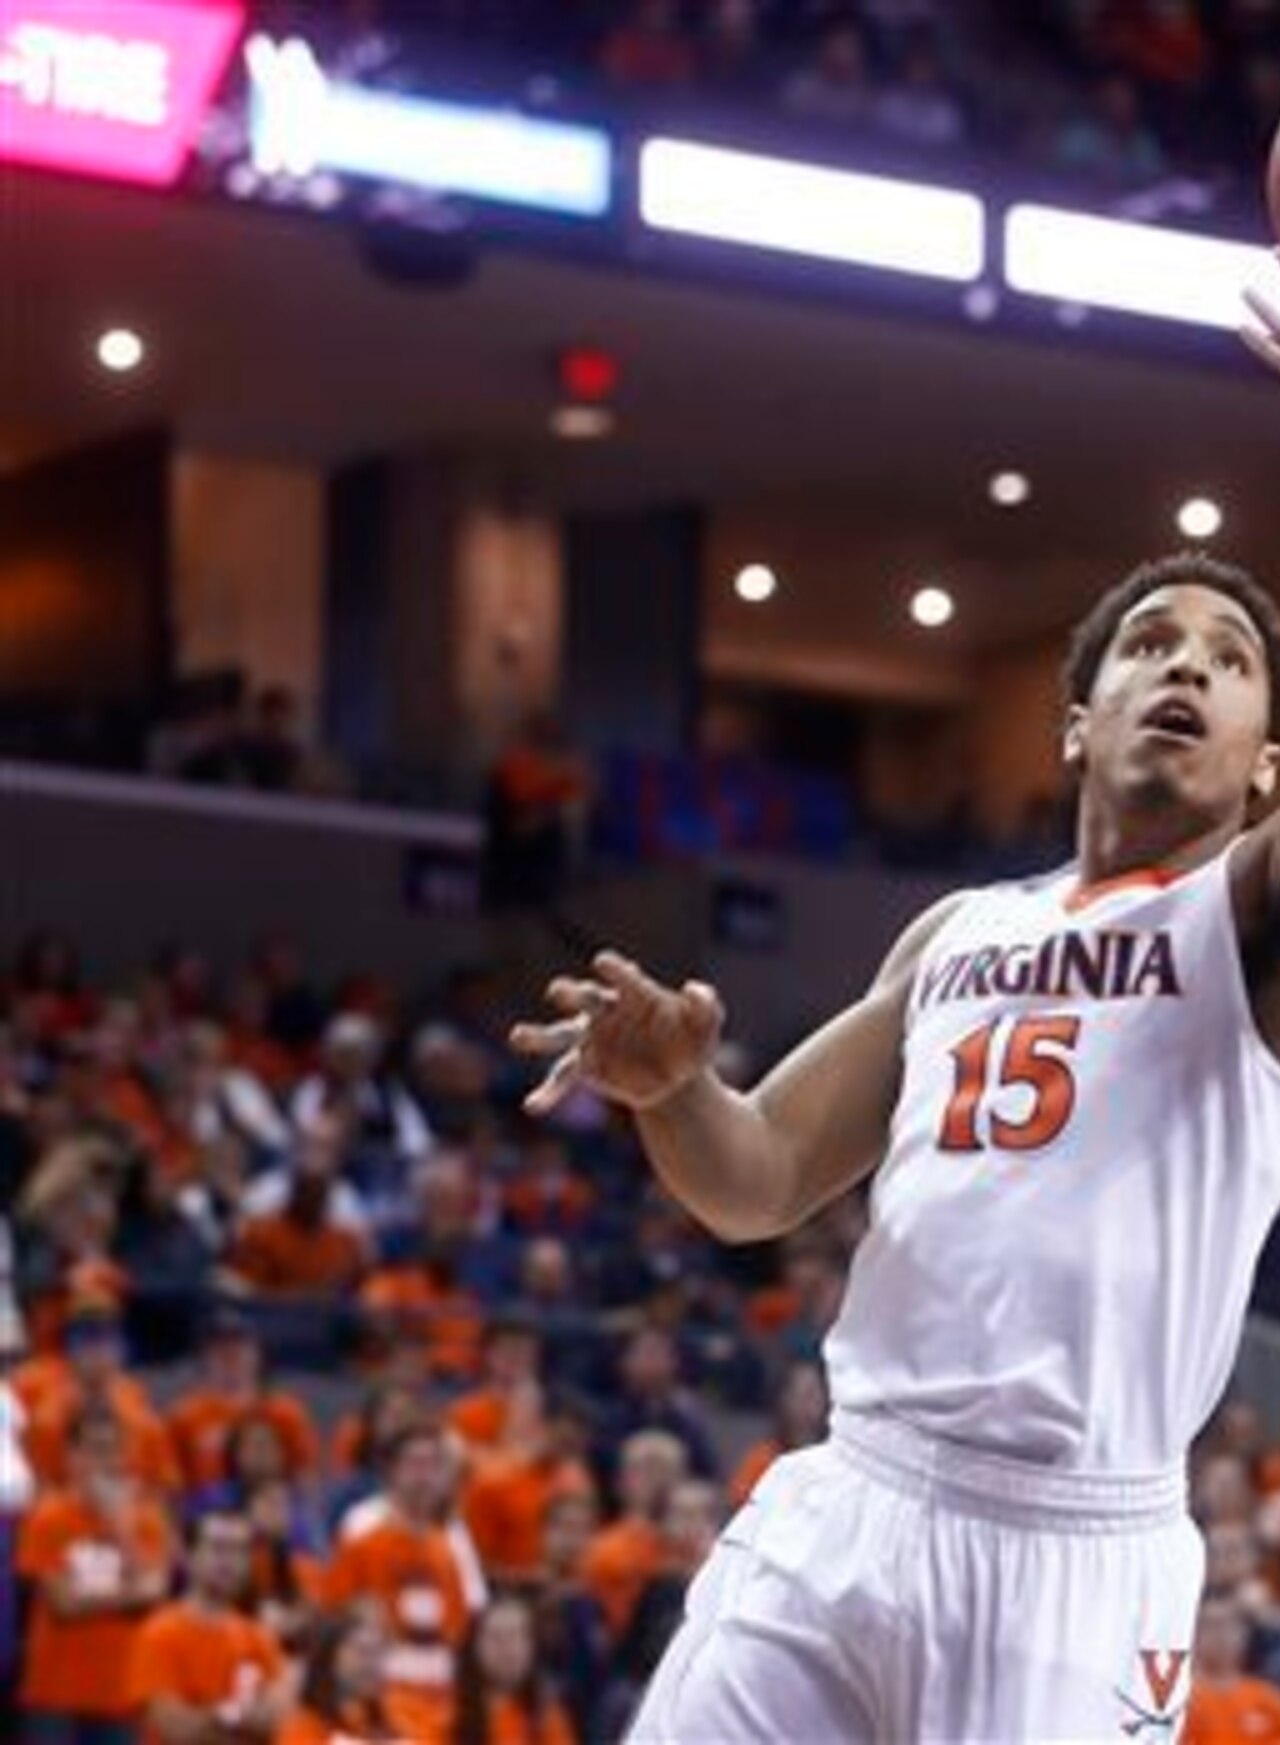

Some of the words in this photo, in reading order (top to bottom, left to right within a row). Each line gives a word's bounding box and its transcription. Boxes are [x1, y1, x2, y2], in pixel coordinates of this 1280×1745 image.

[919, 929, 1183, 1009] VIRGINIA
[937, 1014, 1082, 1153] 15
[1138, 1649, 1189, 1711] V
